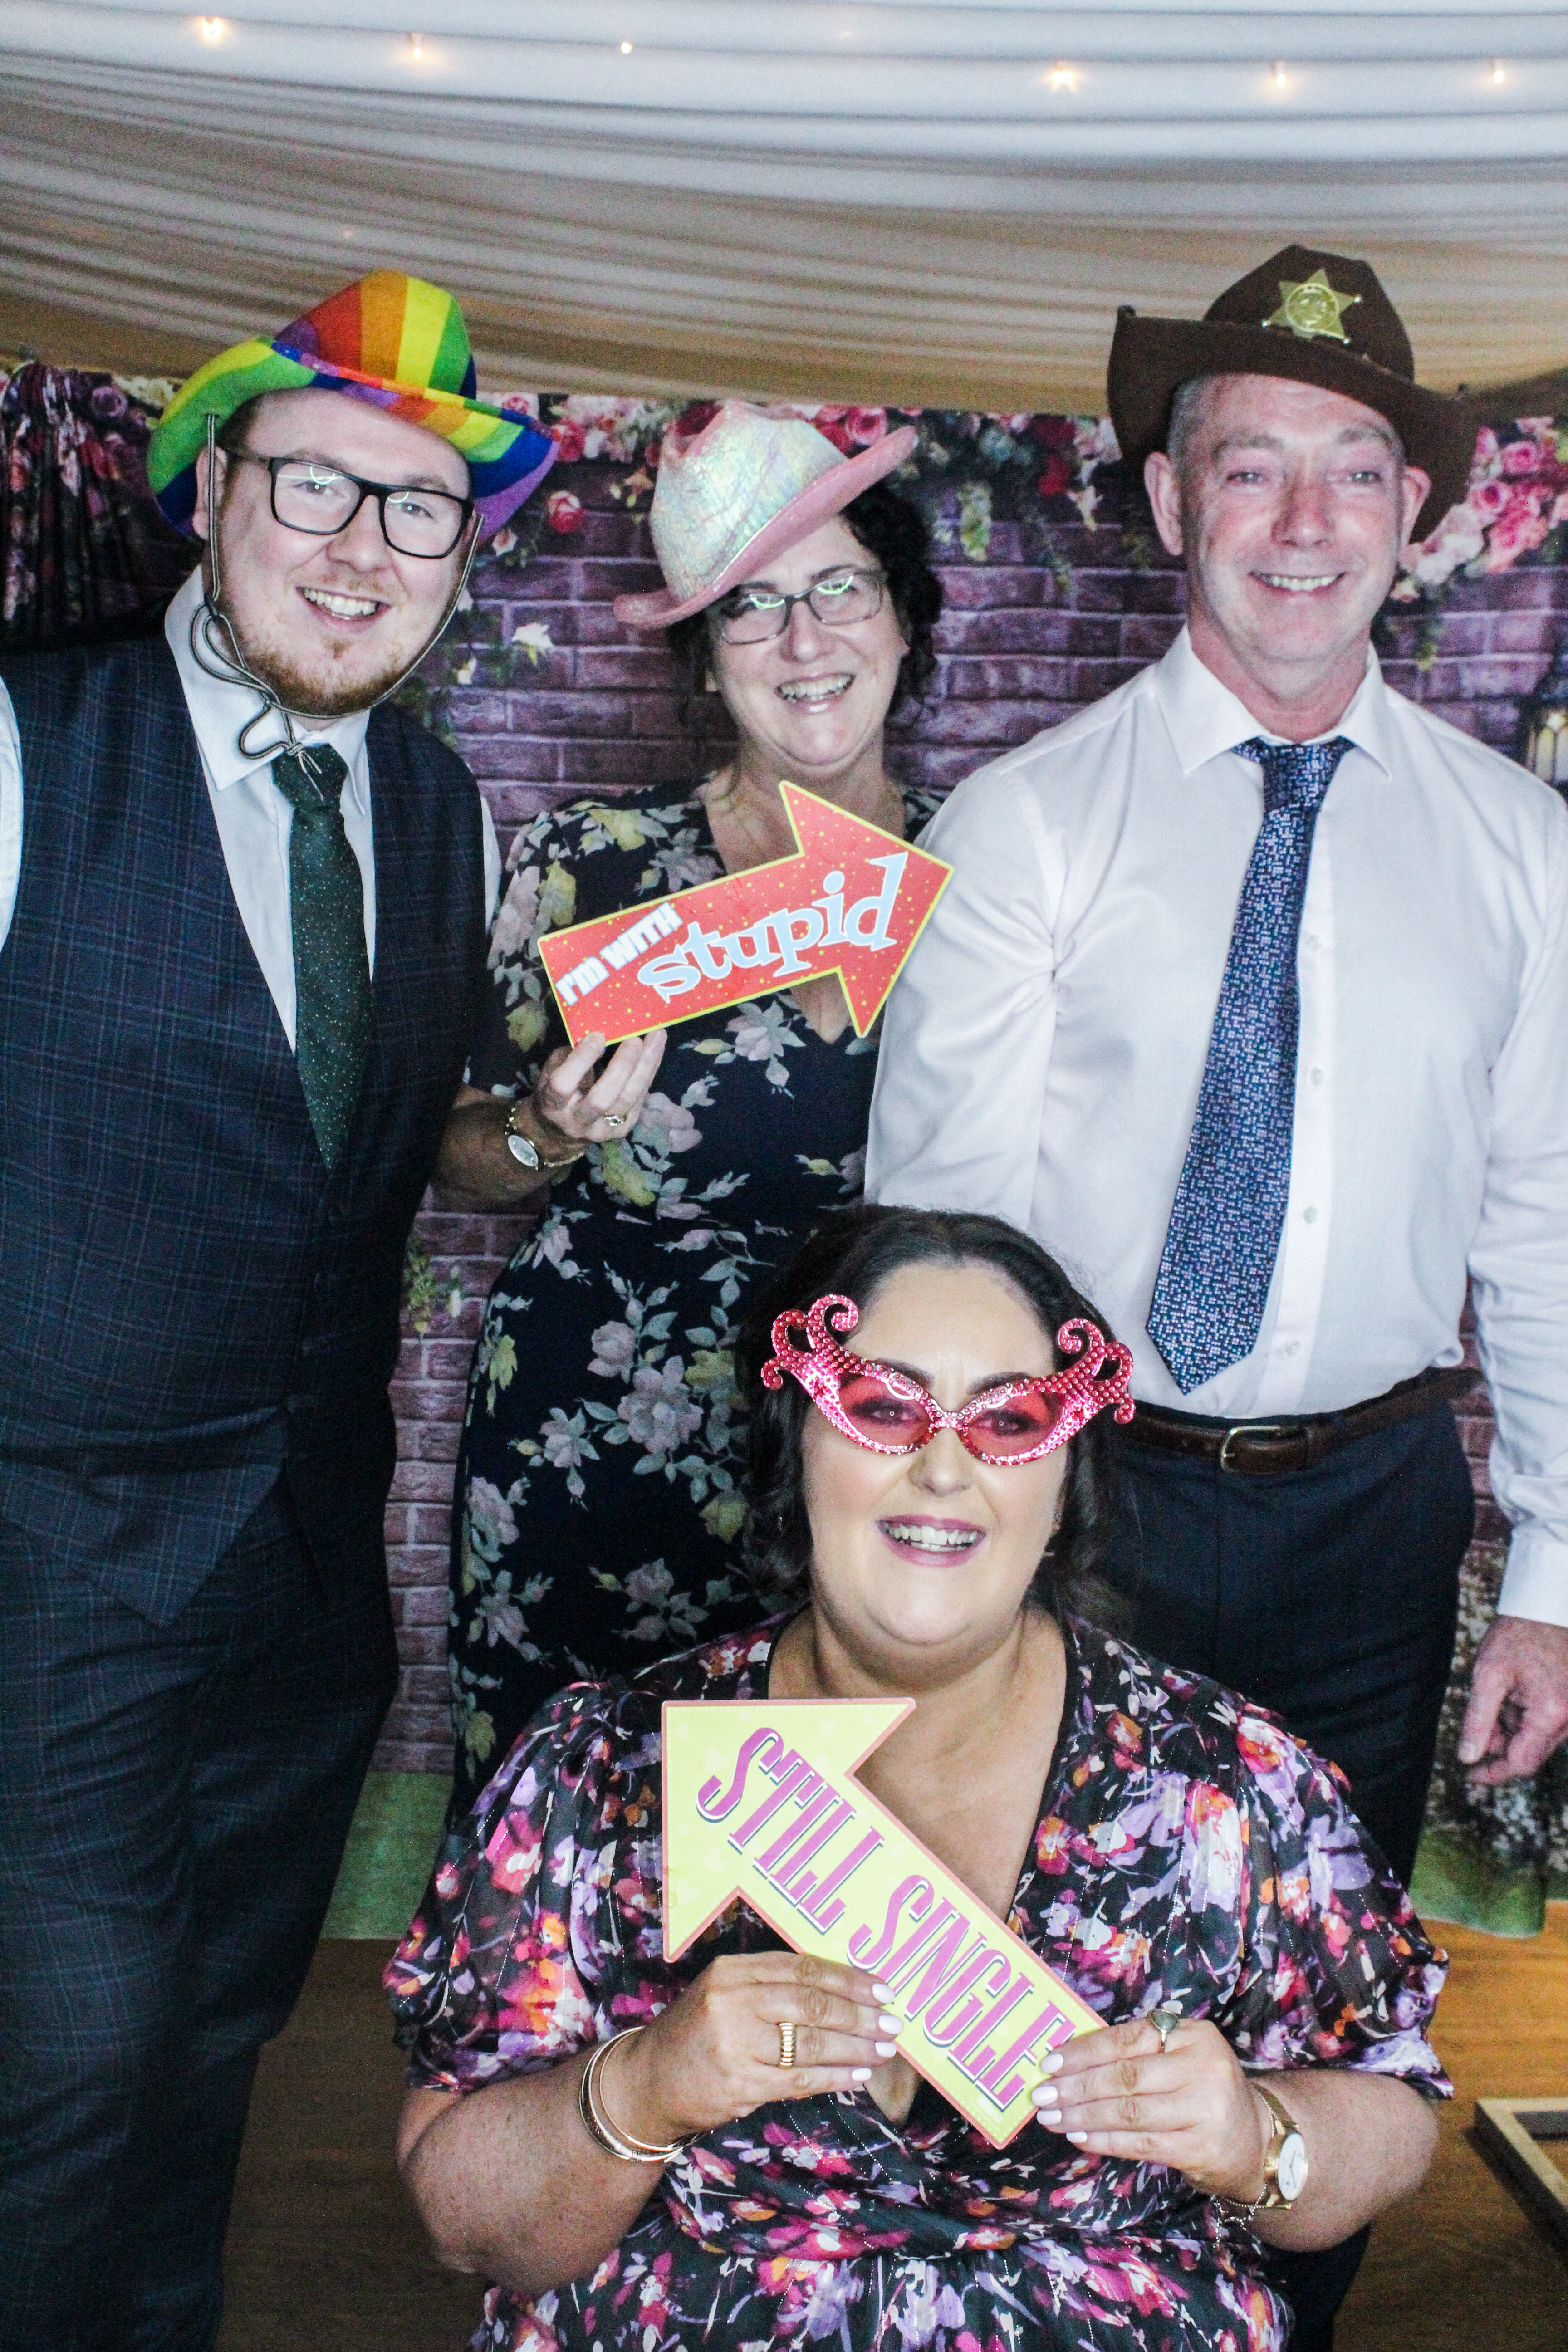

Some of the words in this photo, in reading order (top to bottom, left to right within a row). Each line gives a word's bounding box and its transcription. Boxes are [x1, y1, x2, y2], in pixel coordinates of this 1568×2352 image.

[599, 901, 683, 970] WITH
[637, 851, 908, 1004] stupid
[696, 1727, 884, 1935] STILL
[847, 1875, 1077, 2112] SINGLE
